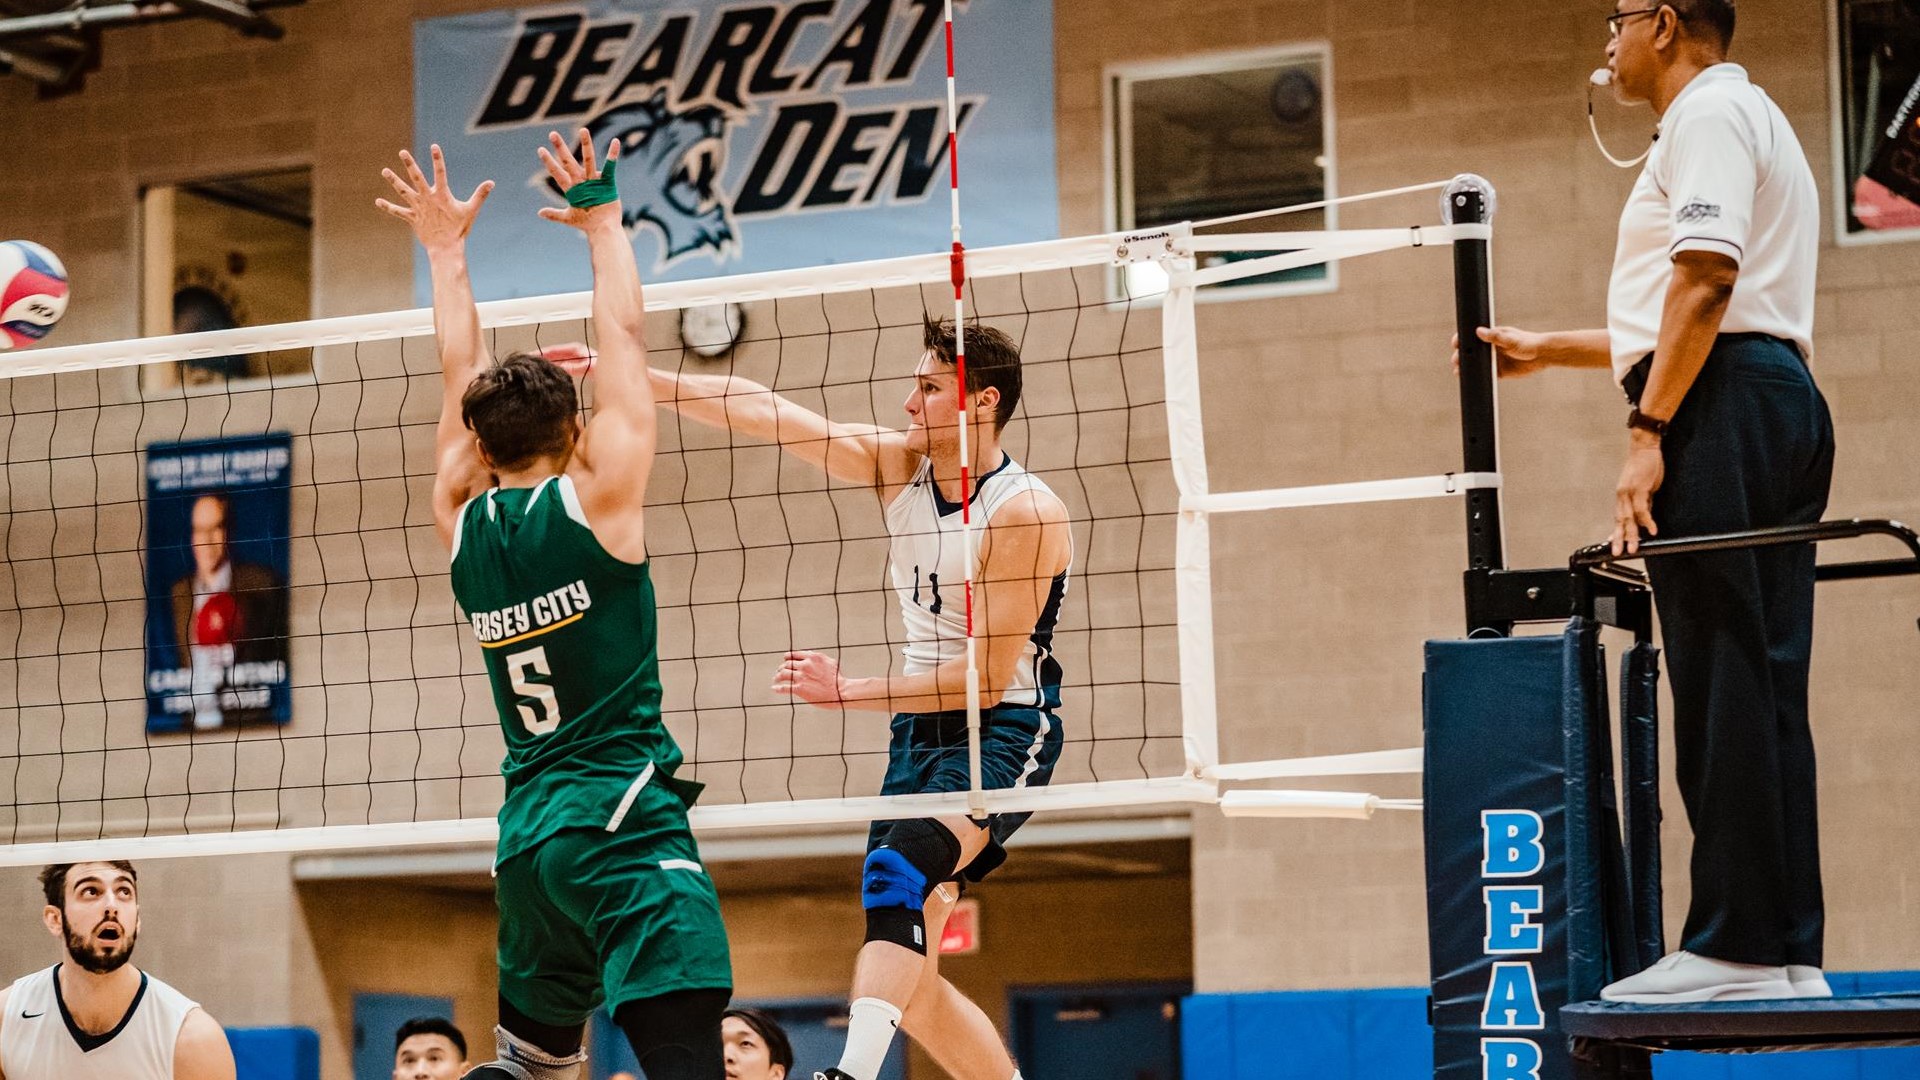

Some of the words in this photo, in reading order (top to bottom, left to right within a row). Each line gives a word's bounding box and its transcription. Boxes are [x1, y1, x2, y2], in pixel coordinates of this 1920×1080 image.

[470, 0, 968, 130] BEARCAT
[730, 98, 982, 217] DEN
[1131, 231, 1170, 242] Senoh
[532, 580, 592, 626] CITY
[912, 564, 943, 615] 11
[505, 645, 562, 736] 5
[1480, 809, 1546, 1080] BEAR
